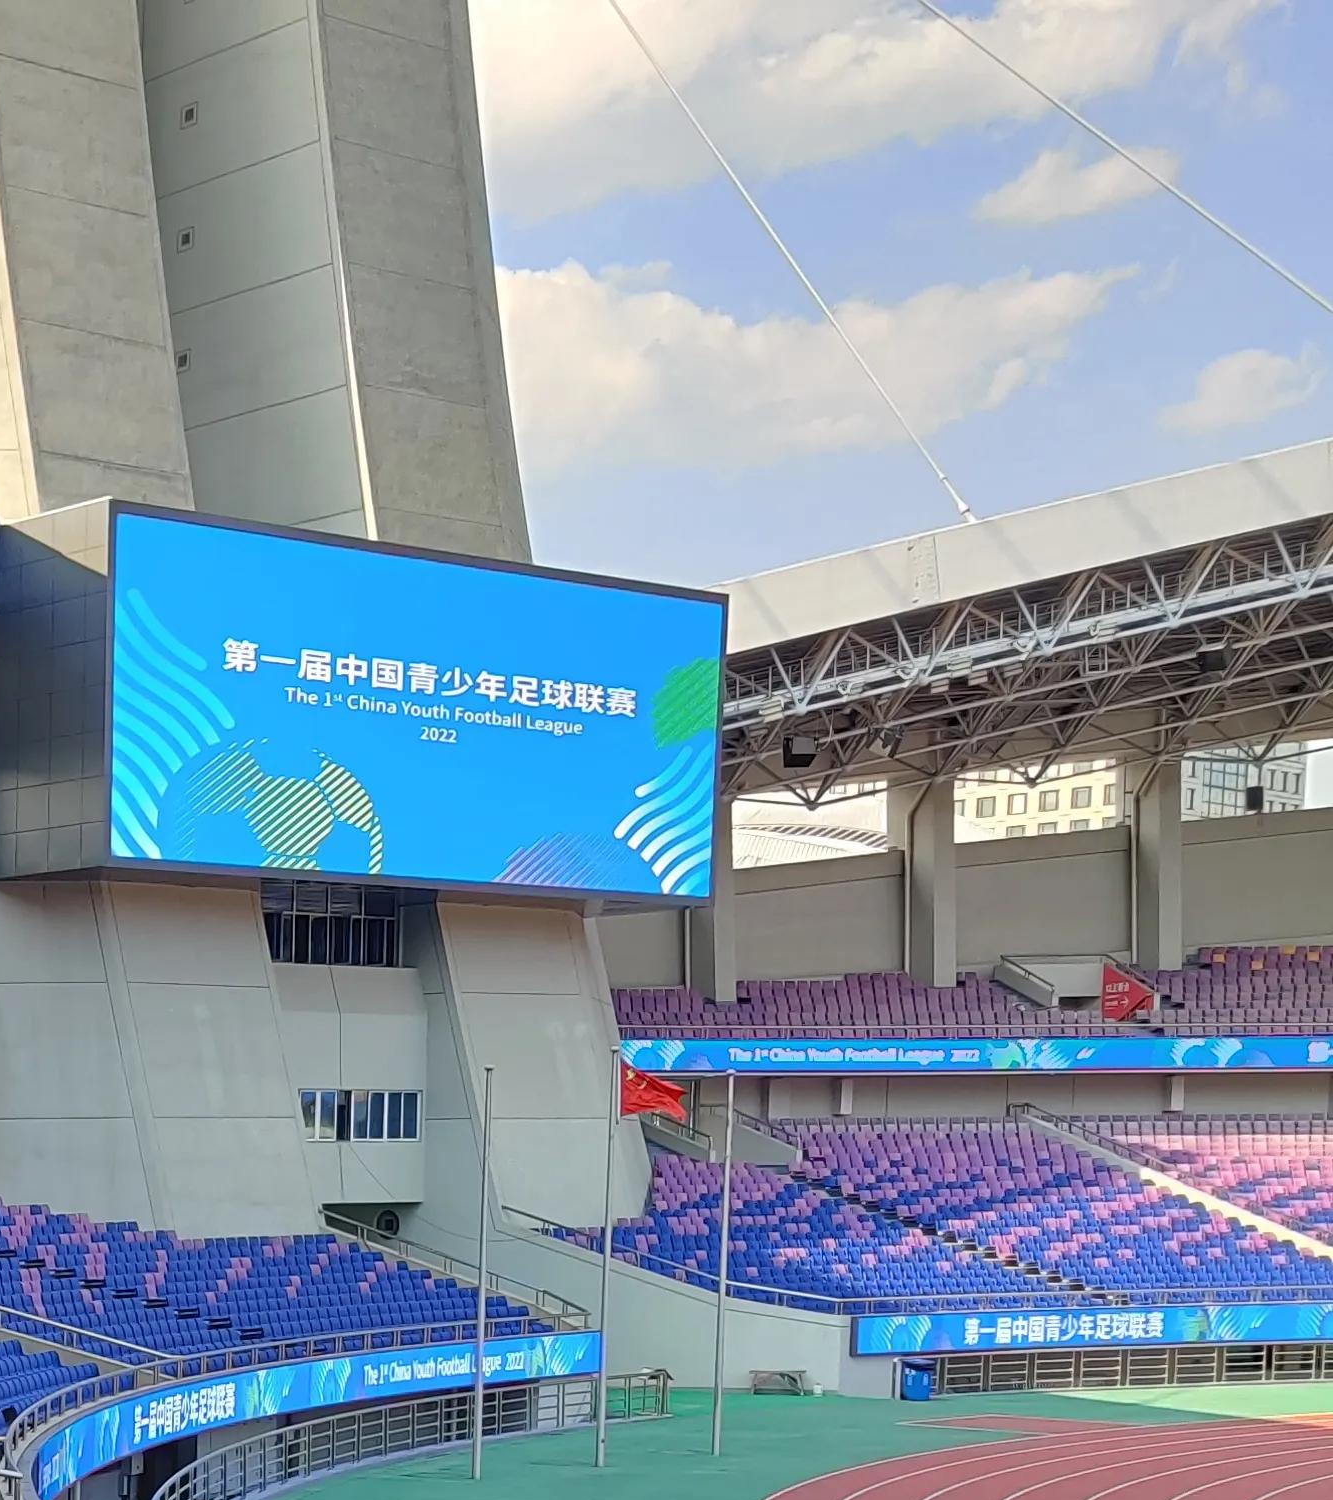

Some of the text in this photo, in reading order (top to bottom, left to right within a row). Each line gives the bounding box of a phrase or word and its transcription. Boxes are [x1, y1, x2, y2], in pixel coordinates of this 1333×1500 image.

[222, 637, 637, 718] 第一届中国青少年足球联赛
[284, 686, 318, 706] The
[346, 694, 397, 715] China
[401, 700, 450, 721] Youth
[454, 706, 522, 729] Football
[526, 714, 584, 737] League
[419, 726, 458, 744] 2022
[964, 1312, 1164, 1345] 第一届中国青少年足球联赛
[133, 1383, 236, 1444] 第一届中国青少年足球联赛
